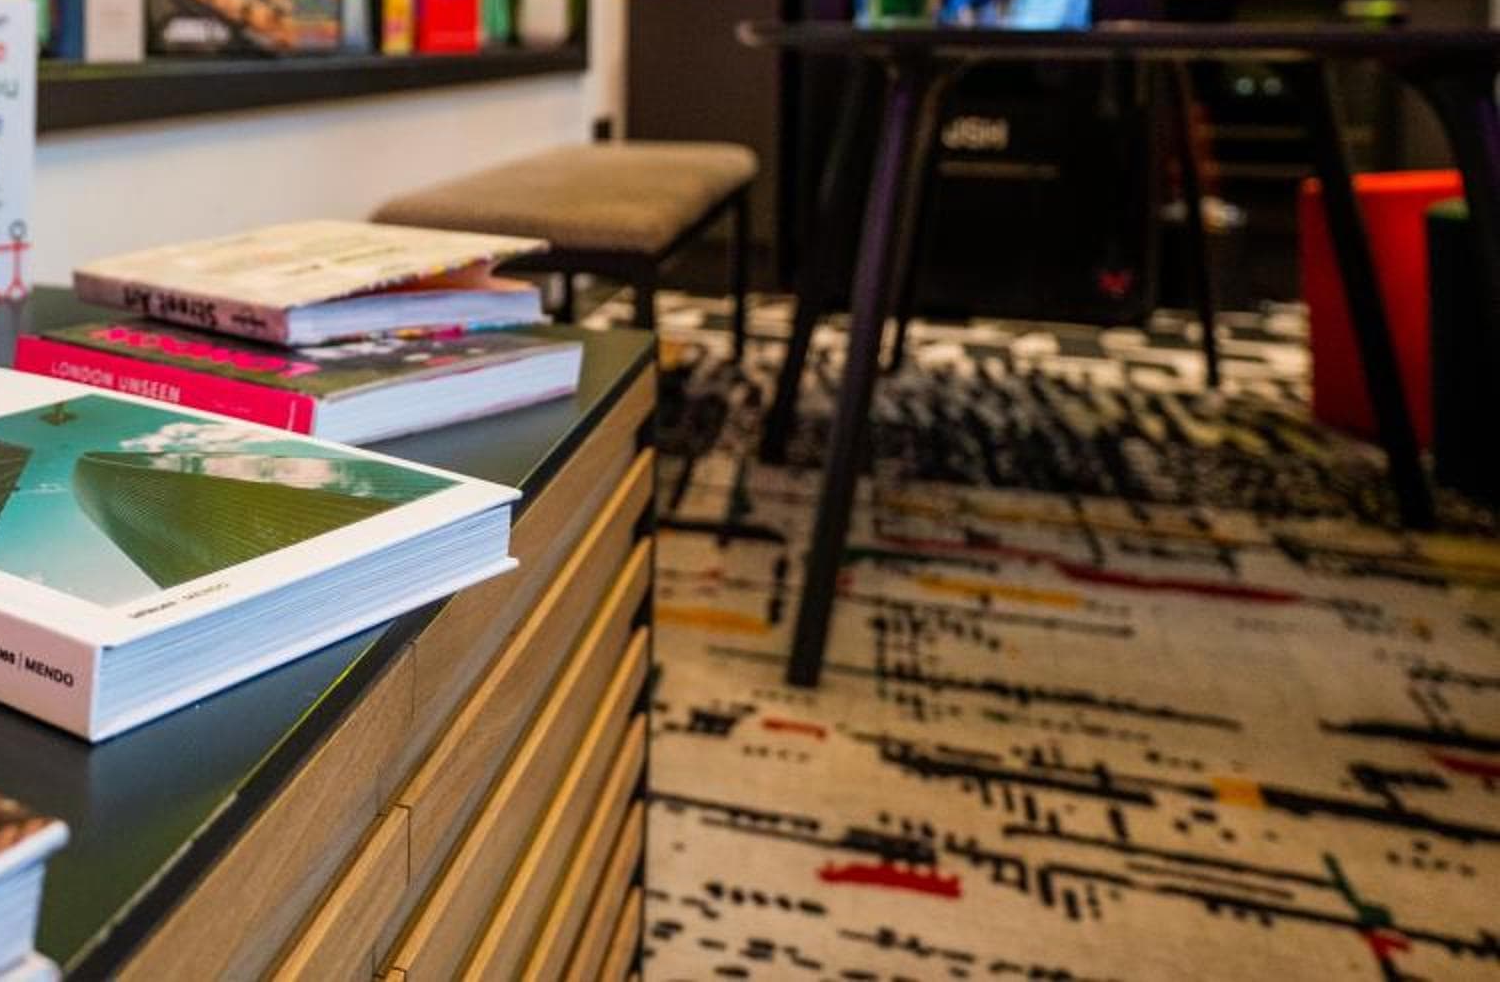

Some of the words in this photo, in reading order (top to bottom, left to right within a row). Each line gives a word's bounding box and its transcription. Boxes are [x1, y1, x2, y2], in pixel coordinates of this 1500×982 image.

[50, 360, 115, 386] LONDON
[118, 376, 182, 404] UNSEEN
[25, 657, 74, 688] MENDO
